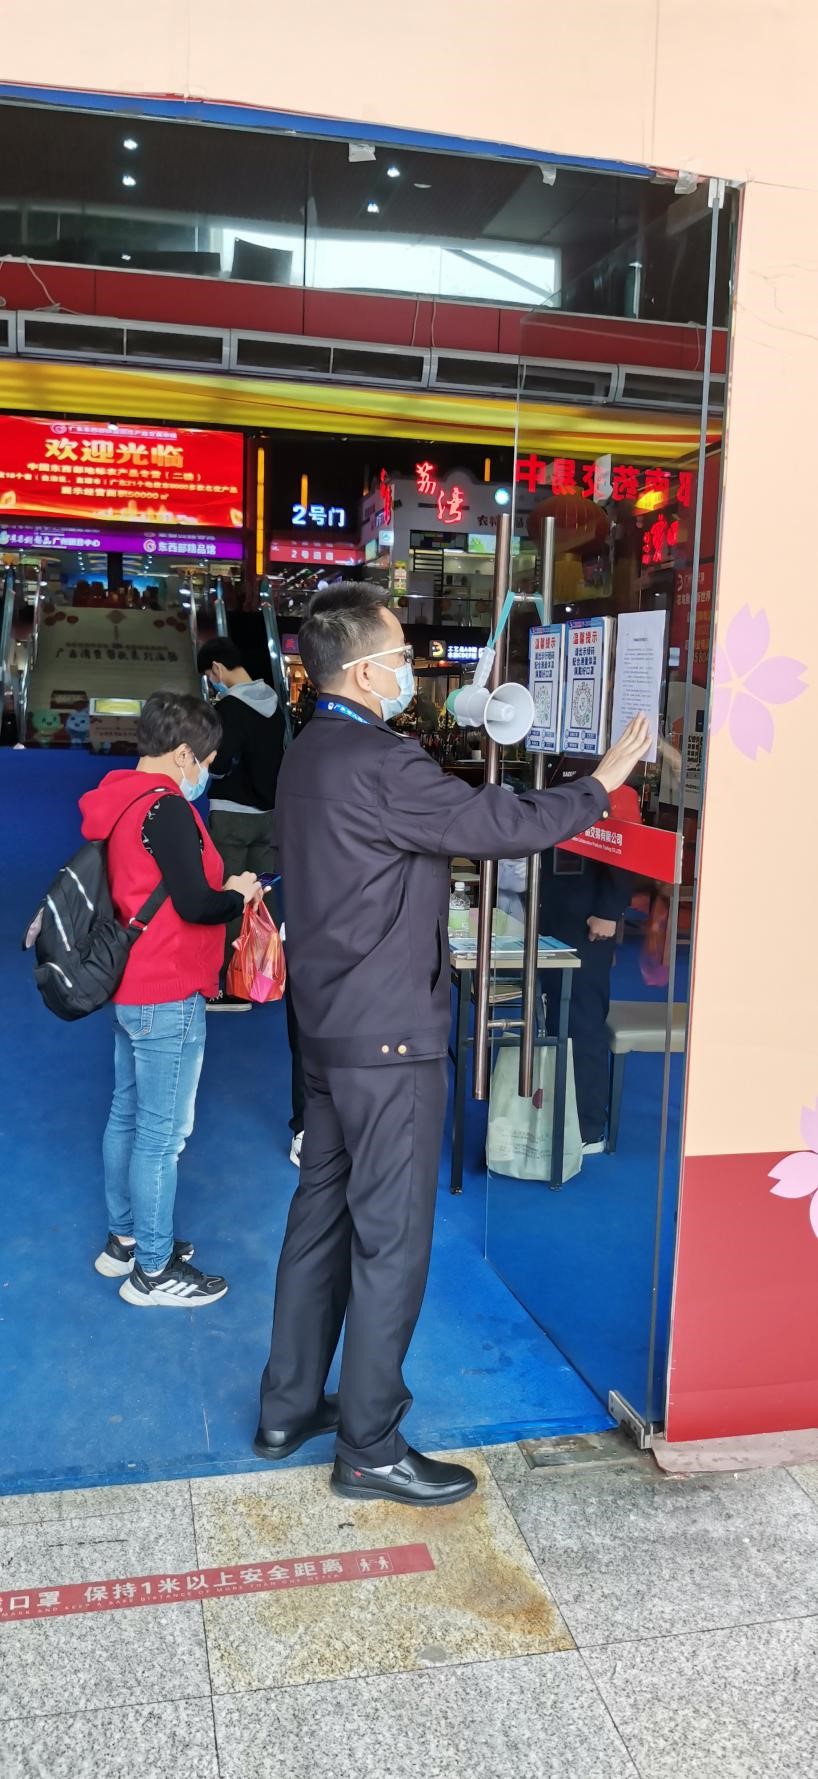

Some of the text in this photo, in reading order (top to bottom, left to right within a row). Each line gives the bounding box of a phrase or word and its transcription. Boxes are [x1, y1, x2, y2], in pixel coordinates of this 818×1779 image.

[44, 437, 184, 468] 欢迎光临
[292, 504, 345, 528] 2号门
[158, 541, 217, 555] 东西部精品馆
[535, 638, 557, 650] 温馨提示
[572, 631, 598, 645] 温馨提示
[572, 656, 597, 667] 配合测量体温
[573, 666, 595, 676] 佩戴好口罩
[0, 1558, 344, 1611] 口罩 保持1米以上安全距离
